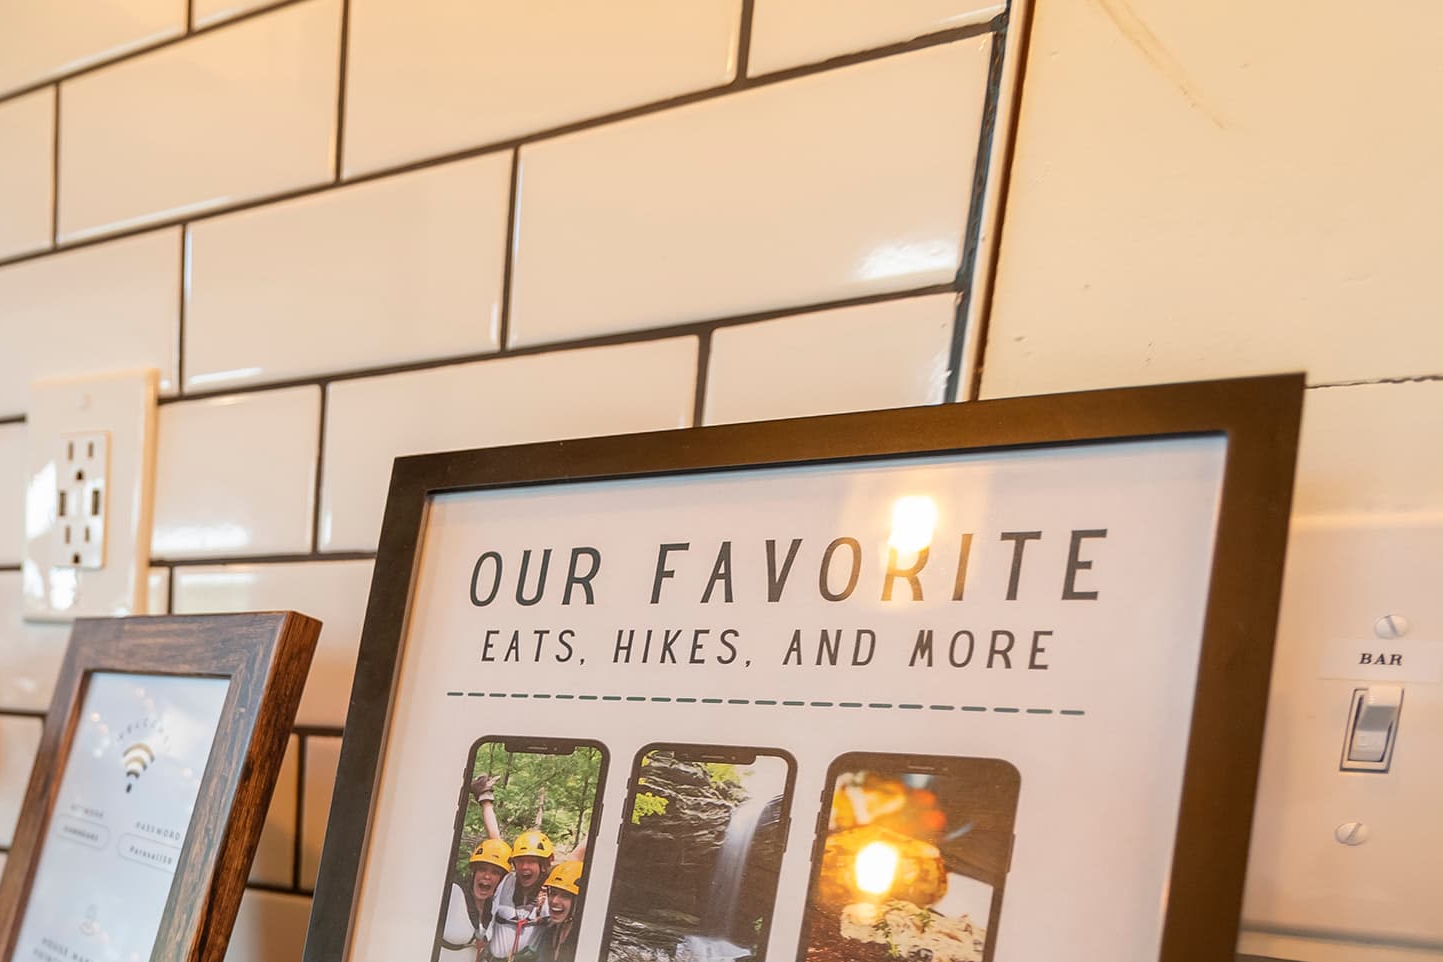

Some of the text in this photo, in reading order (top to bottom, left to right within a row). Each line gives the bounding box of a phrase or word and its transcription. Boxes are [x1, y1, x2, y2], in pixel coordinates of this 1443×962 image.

[469, 529, 1108, 607] OUR FAVORITE
[481, 628, 1054, 670] EATS, HIKES, AND MORE
[1359, 652, 1403, 666] BAR
